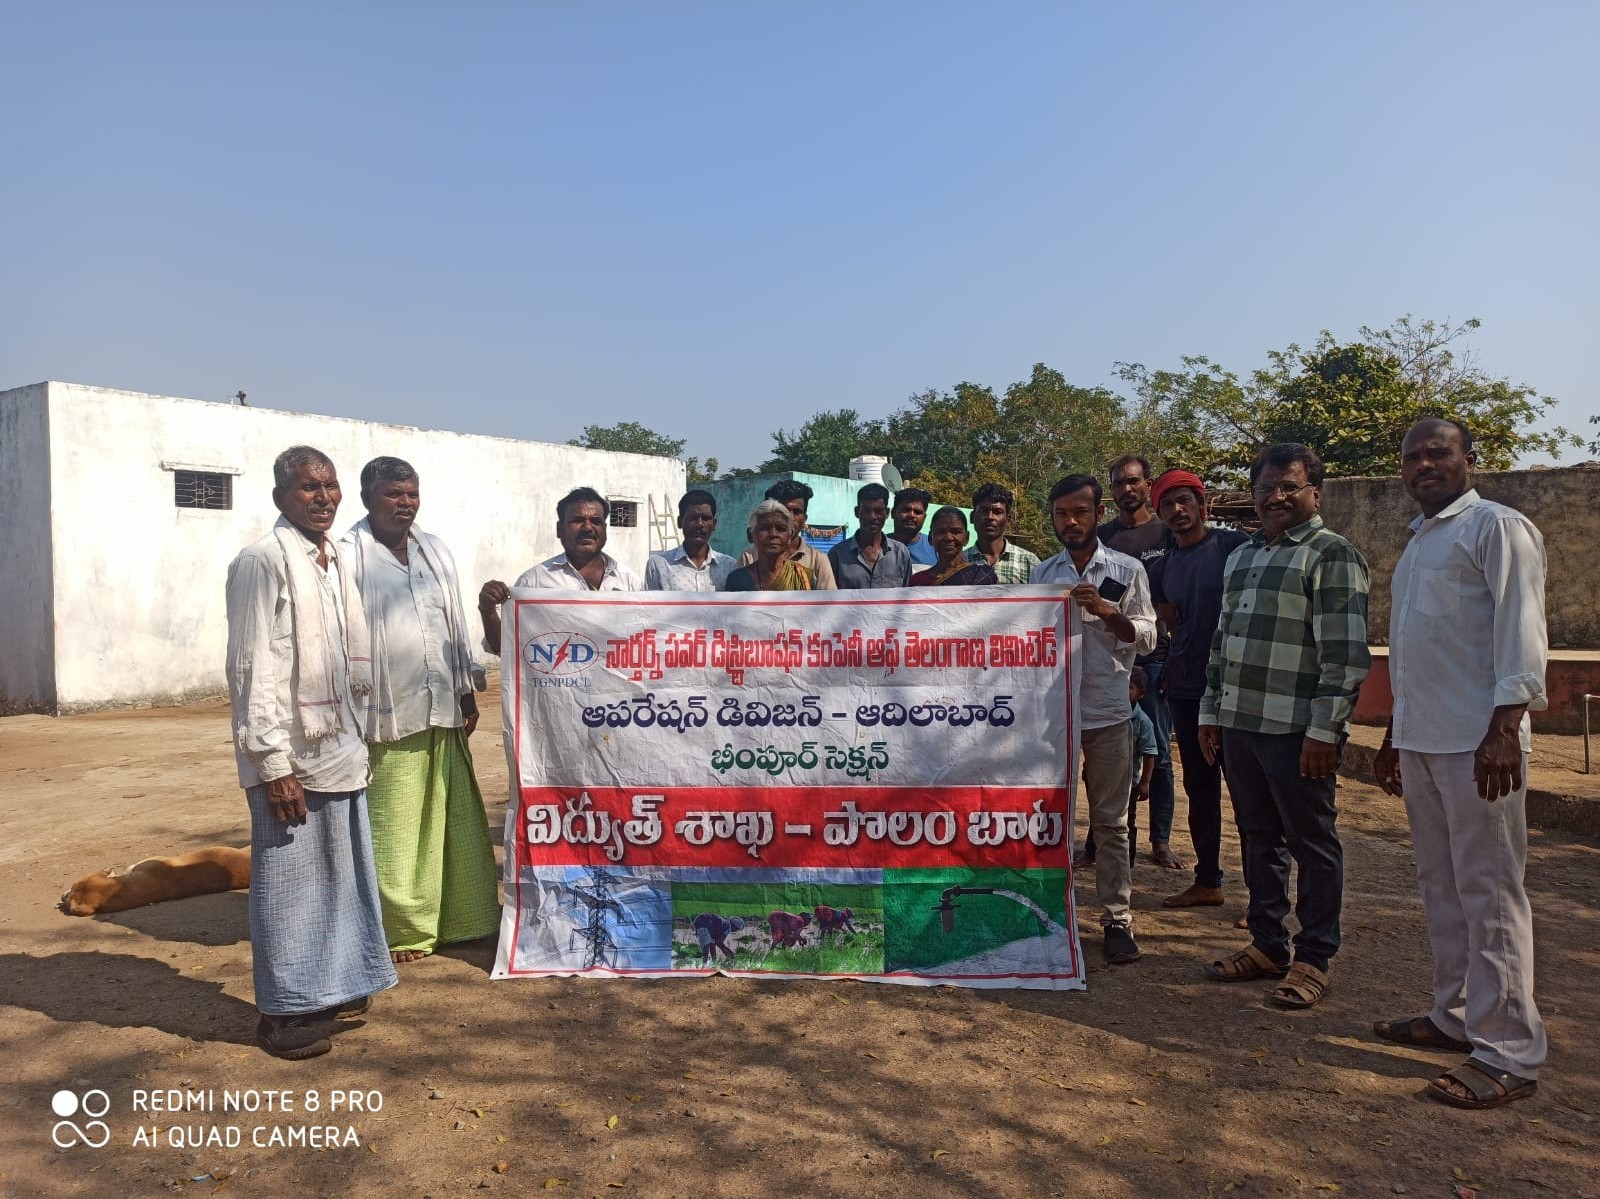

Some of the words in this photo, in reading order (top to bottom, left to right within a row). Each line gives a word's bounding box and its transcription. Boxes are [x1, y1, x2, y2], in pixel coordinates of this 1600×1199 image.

[665, 629, 707, 668] పవర్
[807, 629, 862, 667] కంపెనీ
[867, 628, 900, 674] ఆఫ్
[904, 631, 986, 668] తెలంగాణ
[990, 627, 1057, 668] లిమిటెడ్
[532, 677, 591, 688] TGNPDCL
[582, 693, 709, 733] ఆపరేషన్
[716, 695, 822, 727] డివిజన్
[856, 695, 1015, 727] ఆదిలాబాద్
[711, 741, 818, 776] భీంపూర్
[824, 741, 889, 781] సెక్షన్
[526, 791, 665, 861] విద్యుత్
[674, 811, 774, 858] శాఖ
[823, 801, 956, 846] పొలం
[968, 799, 1063, 846] బాట
